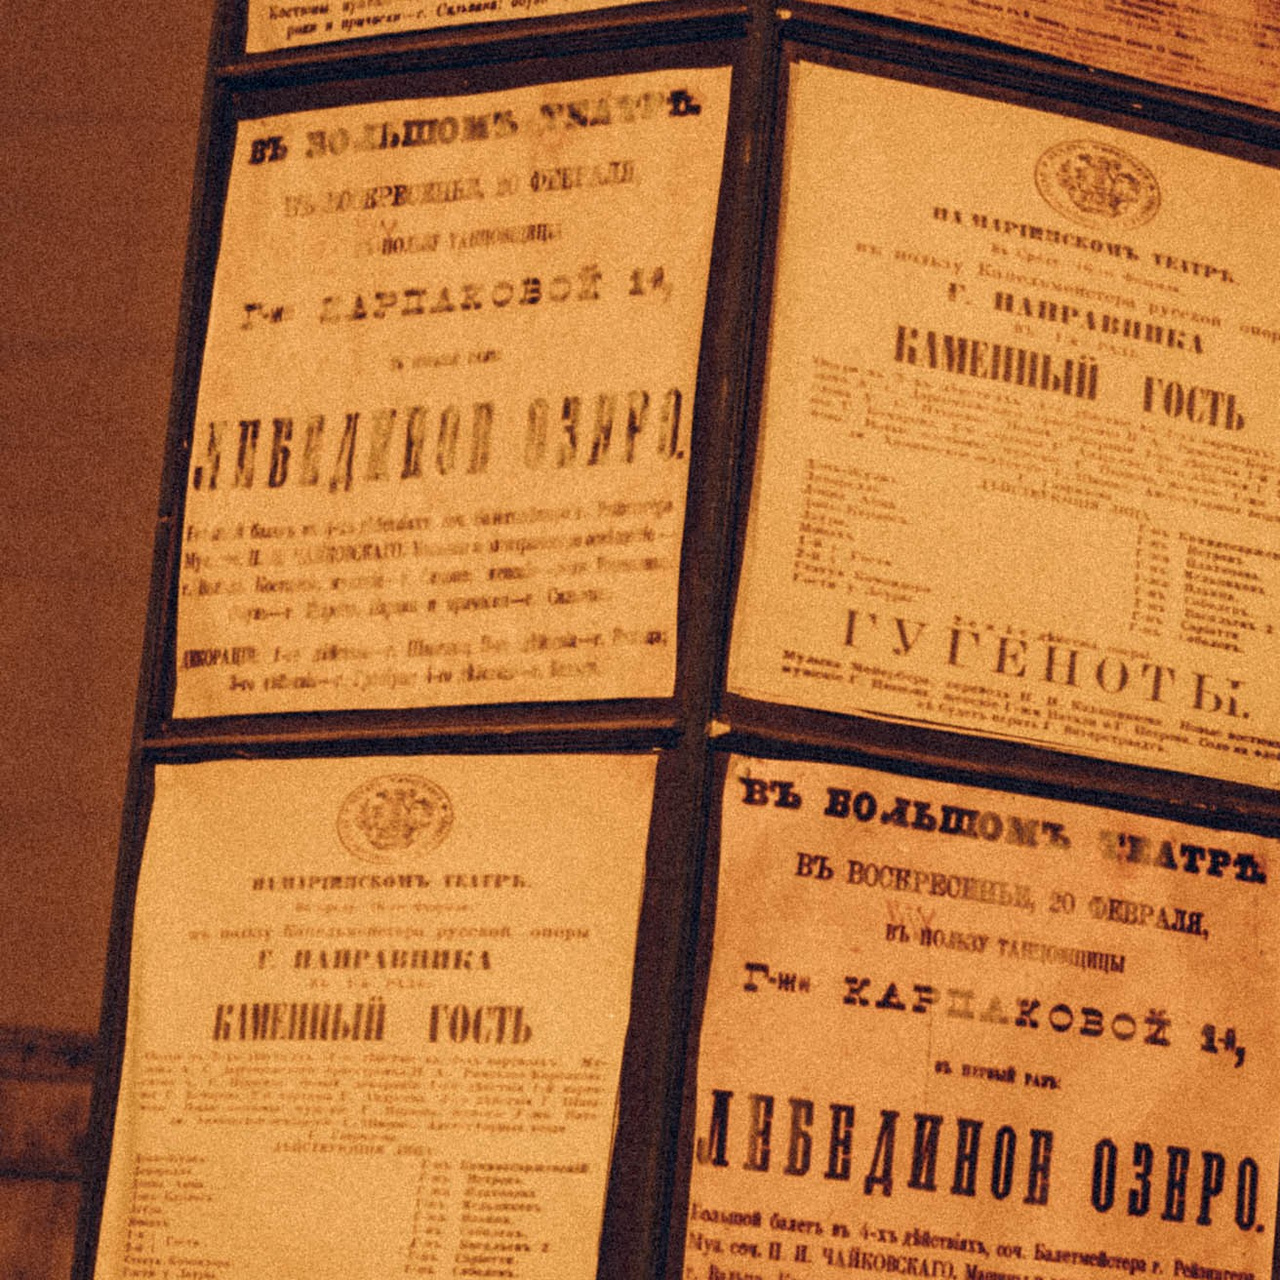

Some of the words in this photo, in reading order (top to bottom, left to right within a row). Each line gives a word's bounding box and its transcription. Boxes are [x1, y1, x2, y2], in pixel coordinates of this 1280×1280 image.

[247, 133, 290, 166] ВЪ
[892, 314, 1100, 403] КАМЕННЫЙ
[1141, 374, 1248, 433] ГОСТЬ
[735, 773, 804, 813] ВЪ
[823, 784, 1073, 854] БОЛЬШОМЪ
[794, 851, 836, 882] ВЪ
[1047, 888, 1076, 916] 20
[1086, 893, 1211, 941] ФЕВРАЛЯ,
[883, 921, 910, 944] ВЪ
[426, 1003, 535, 1045] ГОСТЬ
[841, 965, 1173, 1048] КАРПАКОВОЙ
[692, 1084, 1055, 1217] ЛЕБЕДИНОЕ
[1088, 1135, 1269, 1234] ОЗЕРО.
[768, 1211, 825, 1236] балетъ
[820, 1242, 959, 1280] ЧАЙКОВСКАГО.
